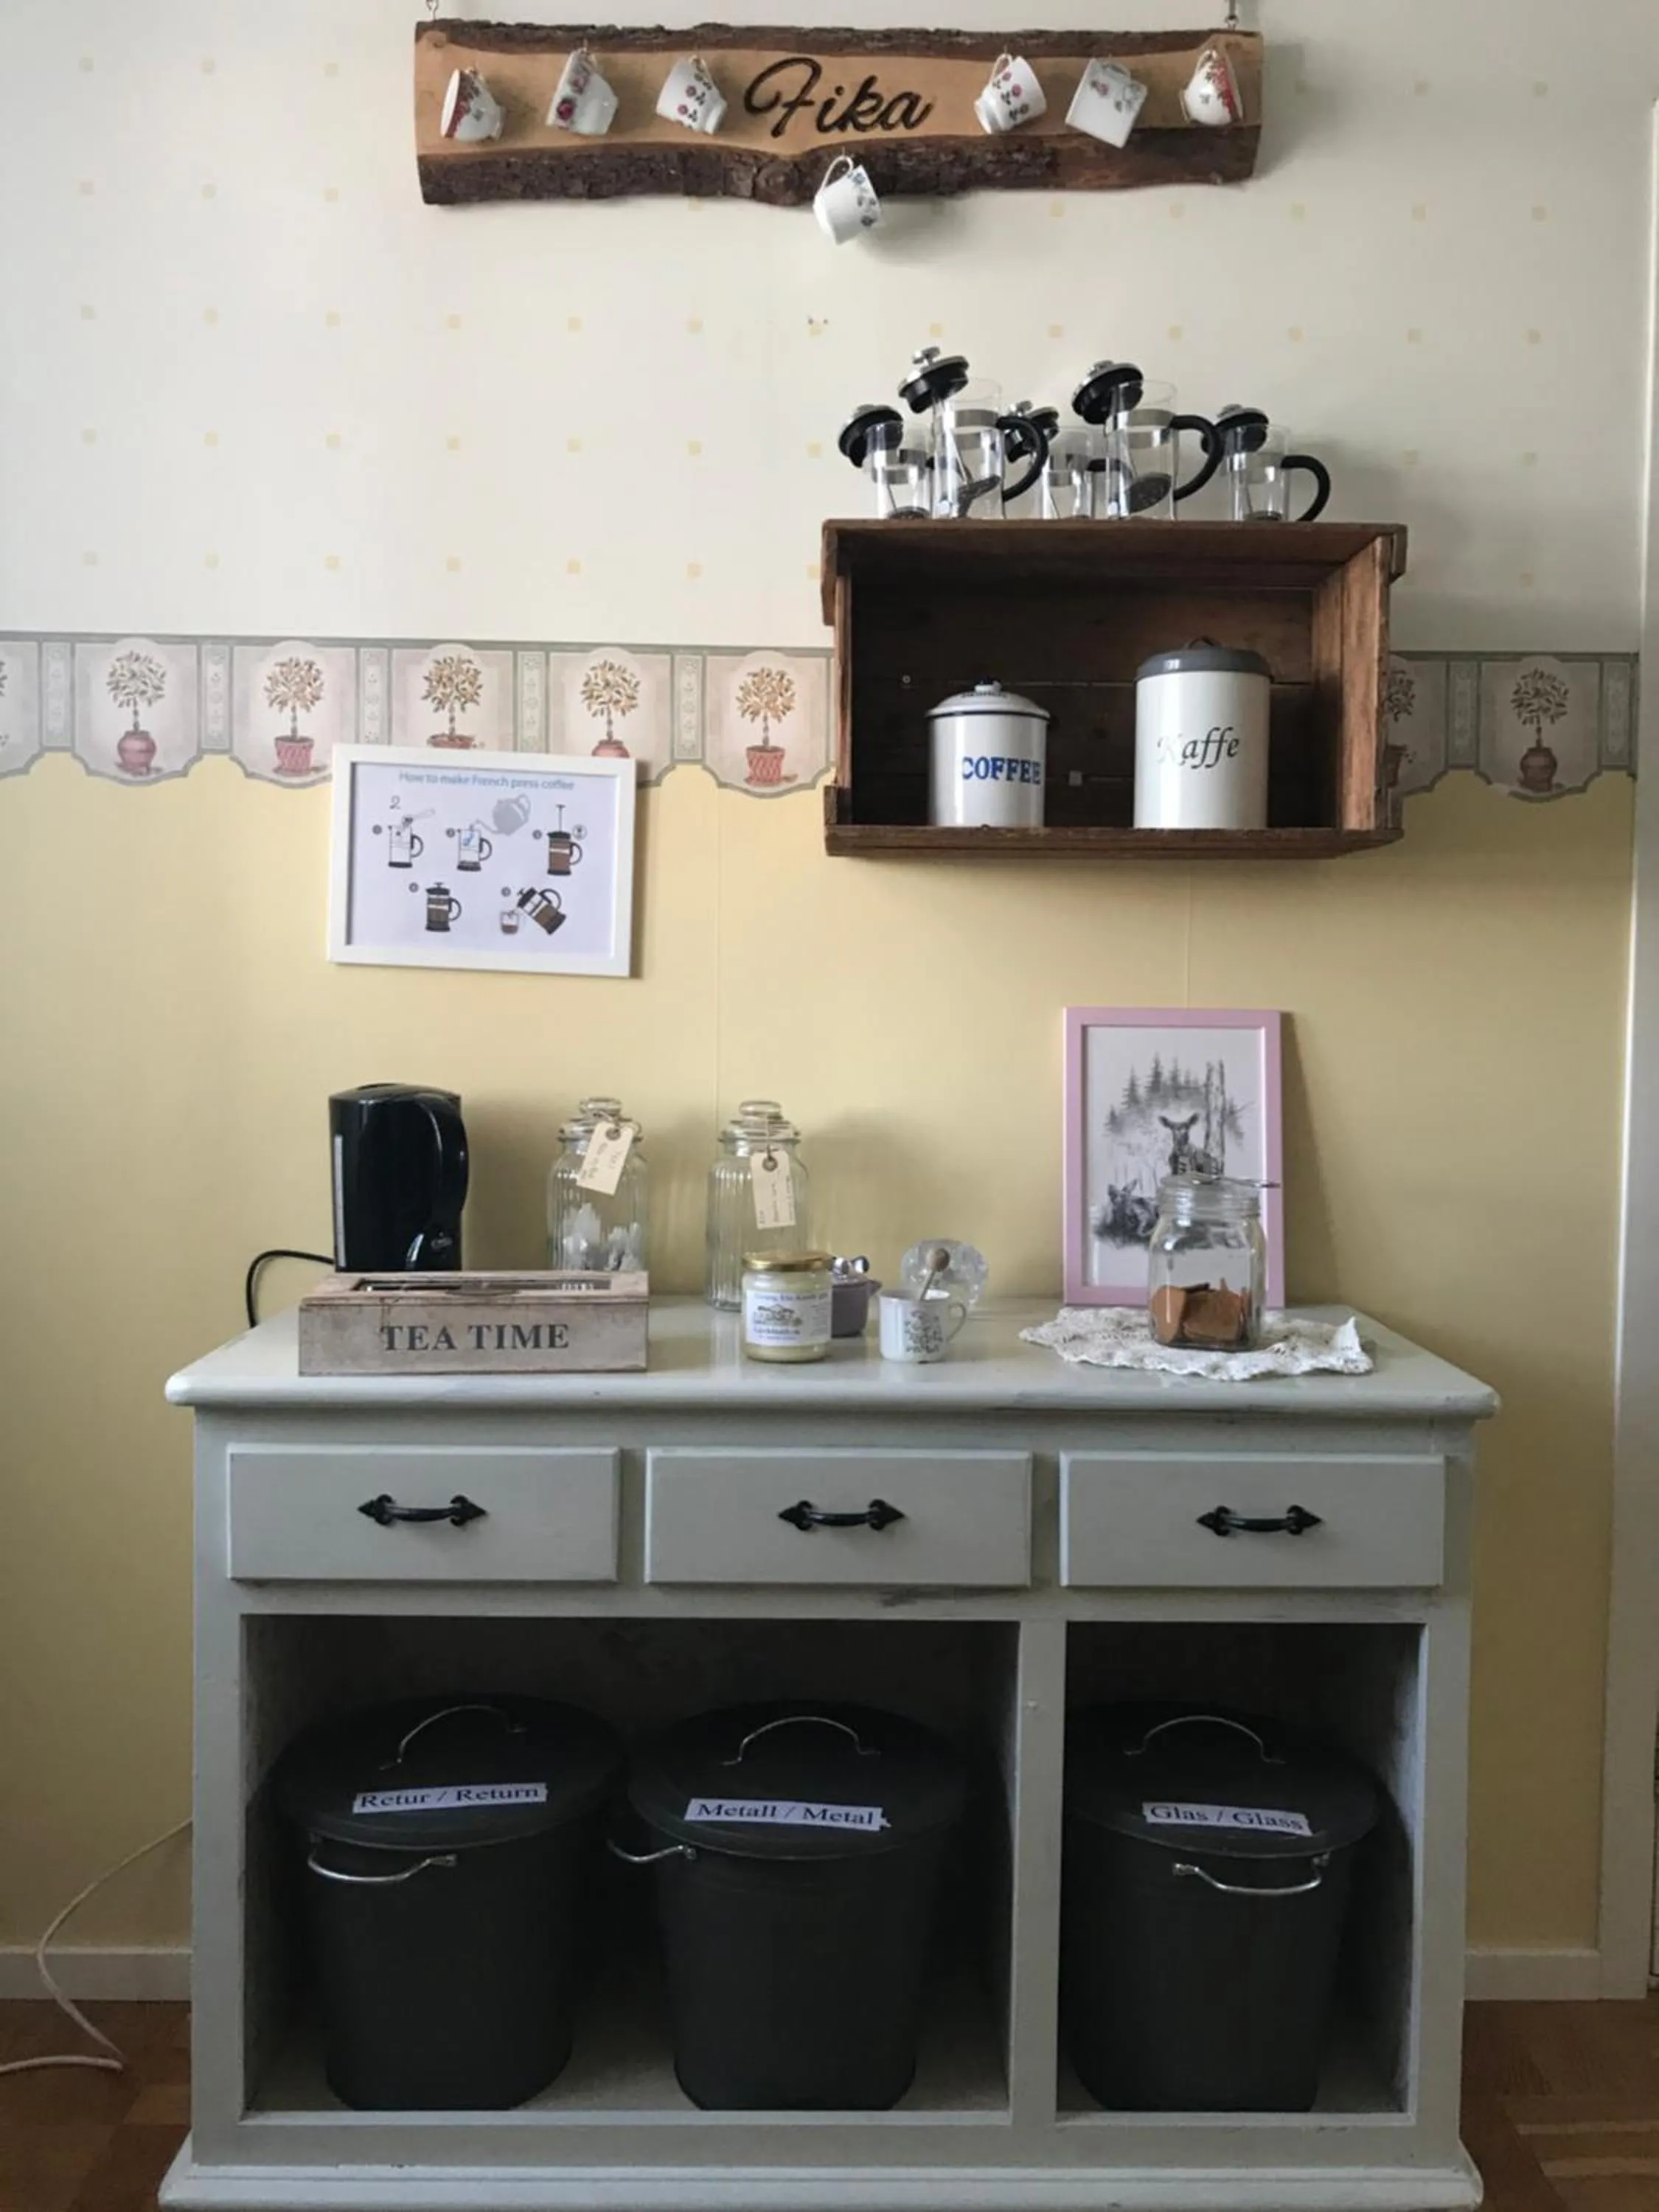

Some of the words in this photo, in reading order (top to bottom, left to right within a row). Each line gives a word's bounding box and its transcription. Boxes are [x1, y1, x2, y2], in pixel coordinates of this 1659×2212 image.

[744, 57, 934, 138] Fika
[399, 773, 424, 784] How
[426, 774, 438, 784] to
[440, 775, 469, 785] make
[472, 776, 509, 788] French
[511, 778, 539, 789] press
[541, 779, 574, 790] coffee
[962, 757, 1041, 785] COFFEE
[382, 1326, 456, 1351] TEA
[468, 1324, 569, 1349] TIME
[361, 1792, 431, 1806] Retur
[456, 1787, 538, 1801] Return
[698, 1804, 777, 1818] Metall
[802, 1807, 873, 1825] Metal
[1150, 1805, 1208, 1821] Glas
[1232, 1811, 1302, 1830] Glass
